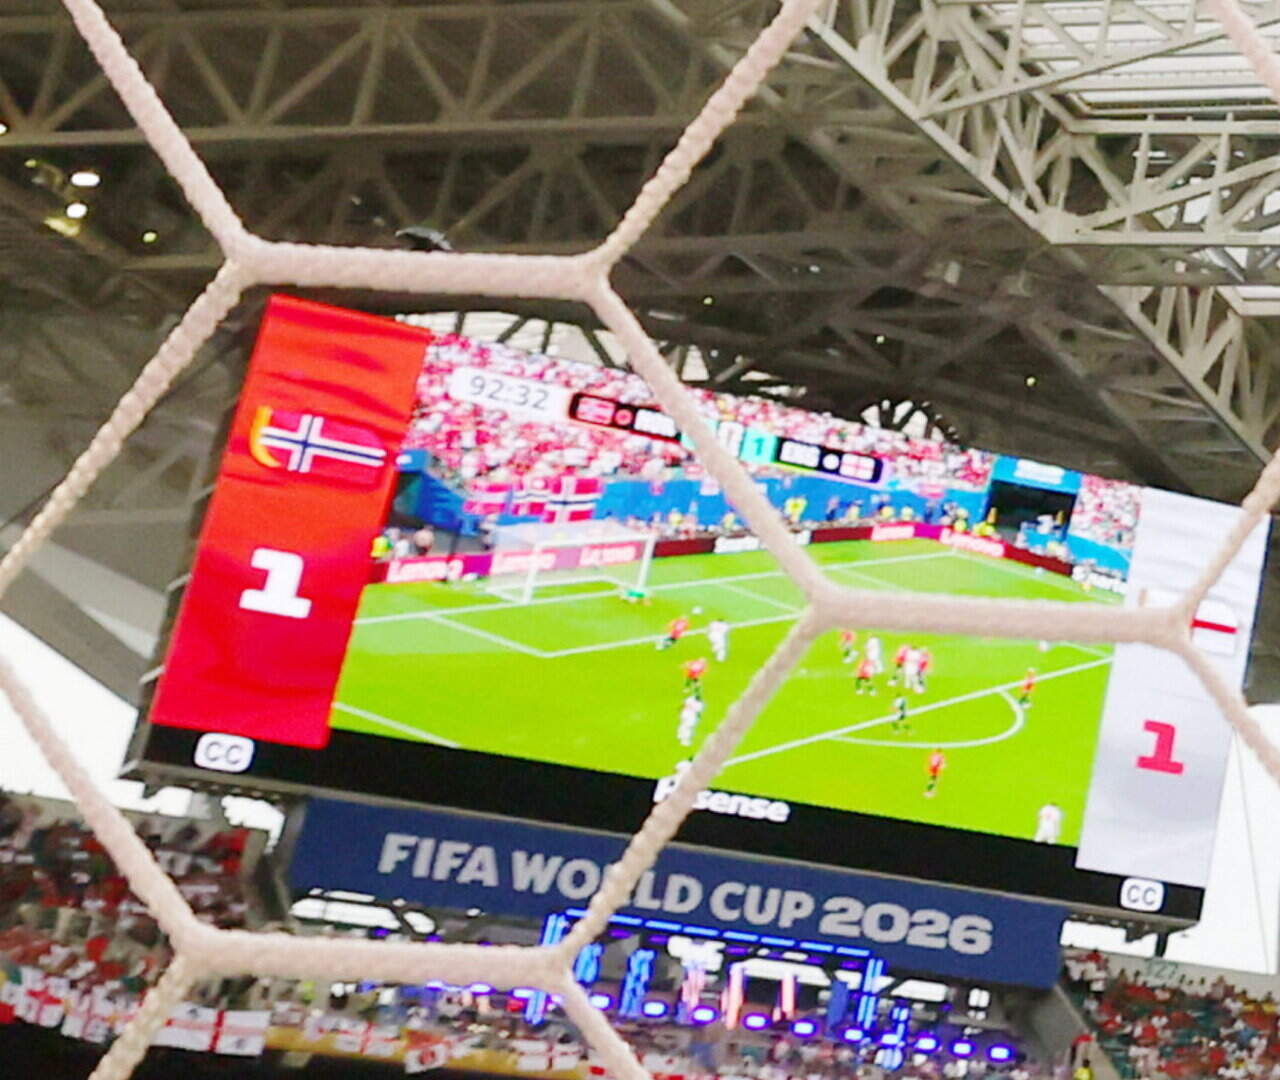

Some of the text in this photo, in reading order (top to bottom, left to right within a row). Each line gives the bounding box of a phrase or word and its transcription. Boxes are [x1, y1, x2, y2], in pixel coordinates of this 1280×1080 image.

[469, 375, 550, 411] 92:32
[238, 548, 312, 618] 1
[200, 740, 244, 769] CC
[1135, 720, 1184, 775] 1
[378, 832, 993, 955] FIFA WOLD CUP 2026
[1126, 884, 1159, 908] CC
